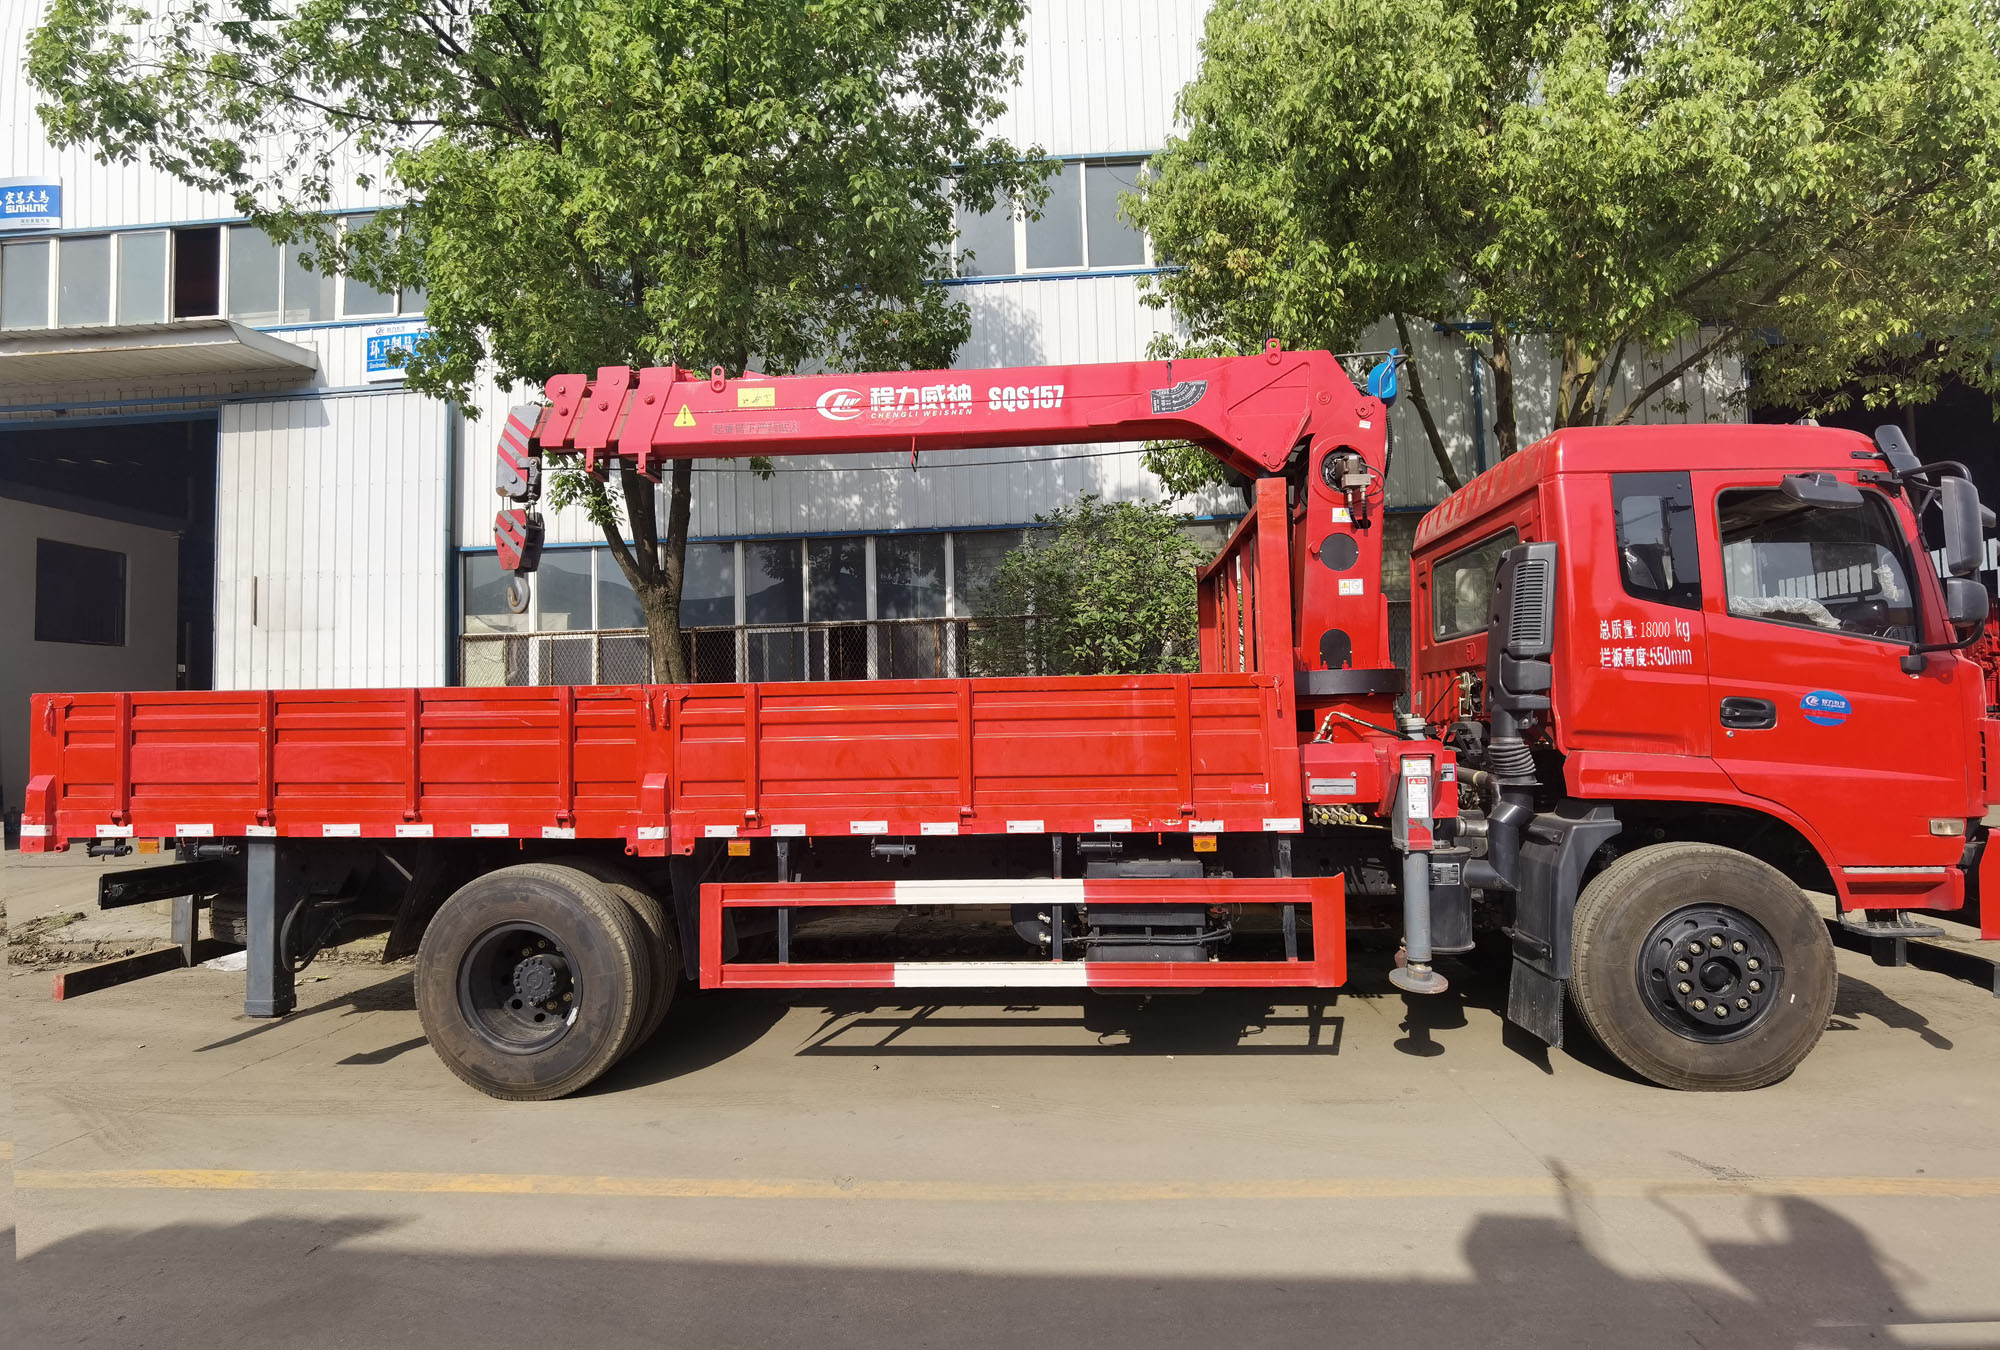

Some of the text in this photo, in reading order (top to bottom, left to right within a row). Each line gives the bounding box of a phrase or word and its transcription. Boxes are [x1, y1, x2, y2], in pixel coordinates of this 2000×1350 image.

[6, 204, 48, 213] SUNHUNK
[870, 384, 972, 412] 程力威神
[988, 385, 1064, 412] SQS157
[870, 409, 973, 419] CHENGLI WEISHEN
[1600, 617, 1690, 642] 总质量: 18000 kg
